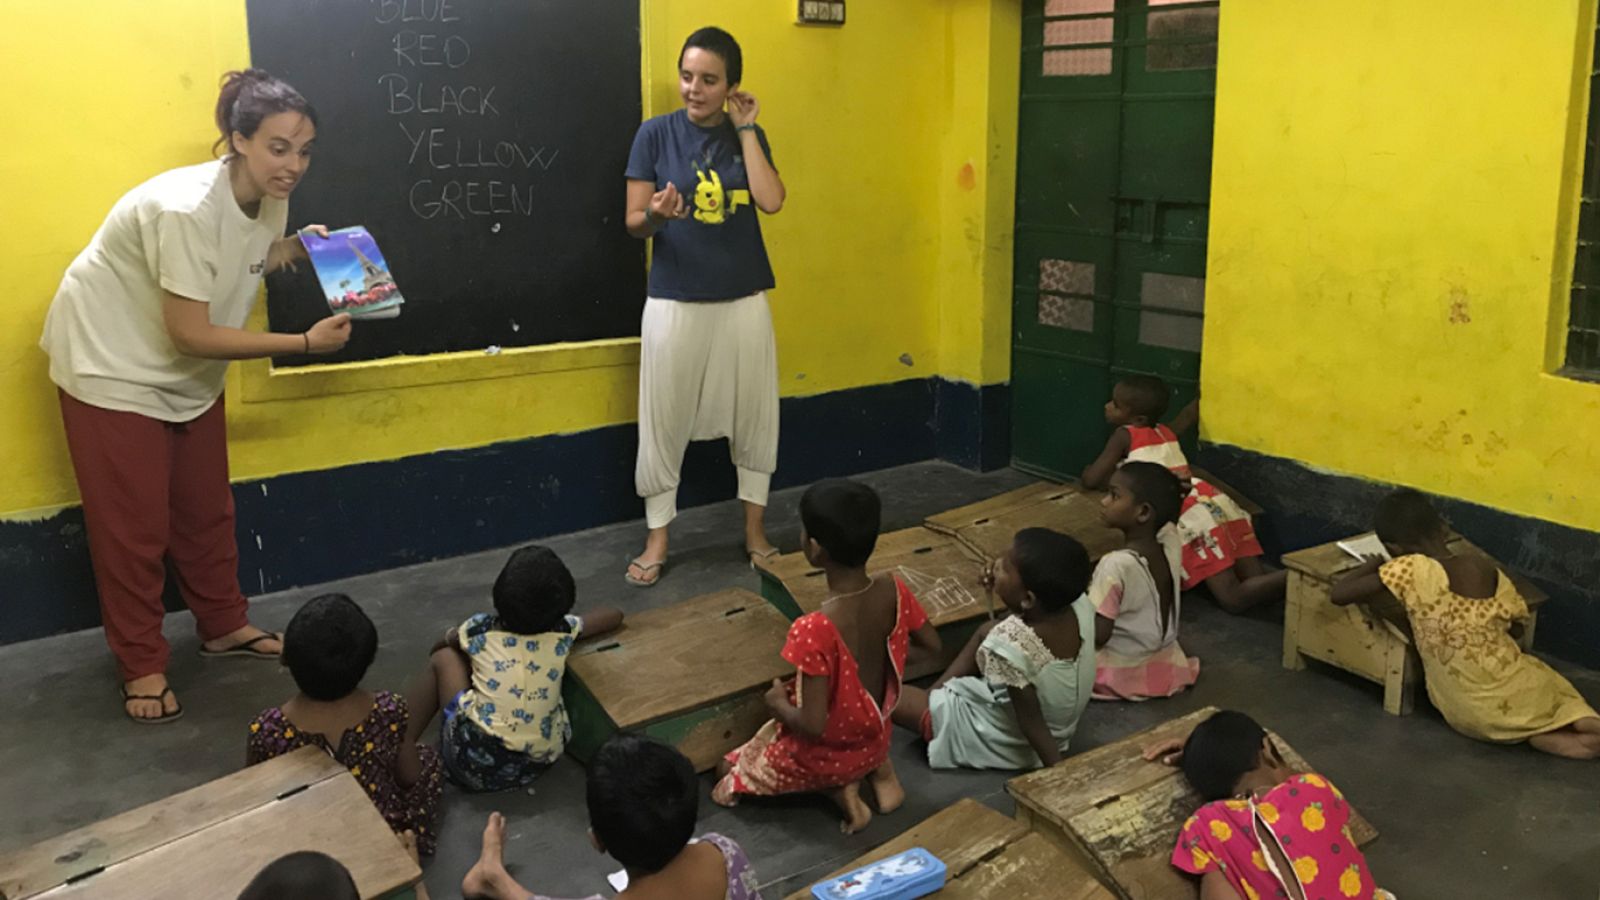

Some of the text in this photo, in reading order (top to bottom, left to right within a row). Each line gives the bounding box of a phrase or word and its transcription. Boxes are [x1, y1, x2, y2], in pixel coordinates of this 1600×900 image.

[370, 0, 460, 23] BLUE
[392, 30, 471, 68] RED
[378, 73, 499, 115] BLACK
[399, 121, 560, 170] YELLOW
[409, 179, 534, 219] GREEN
